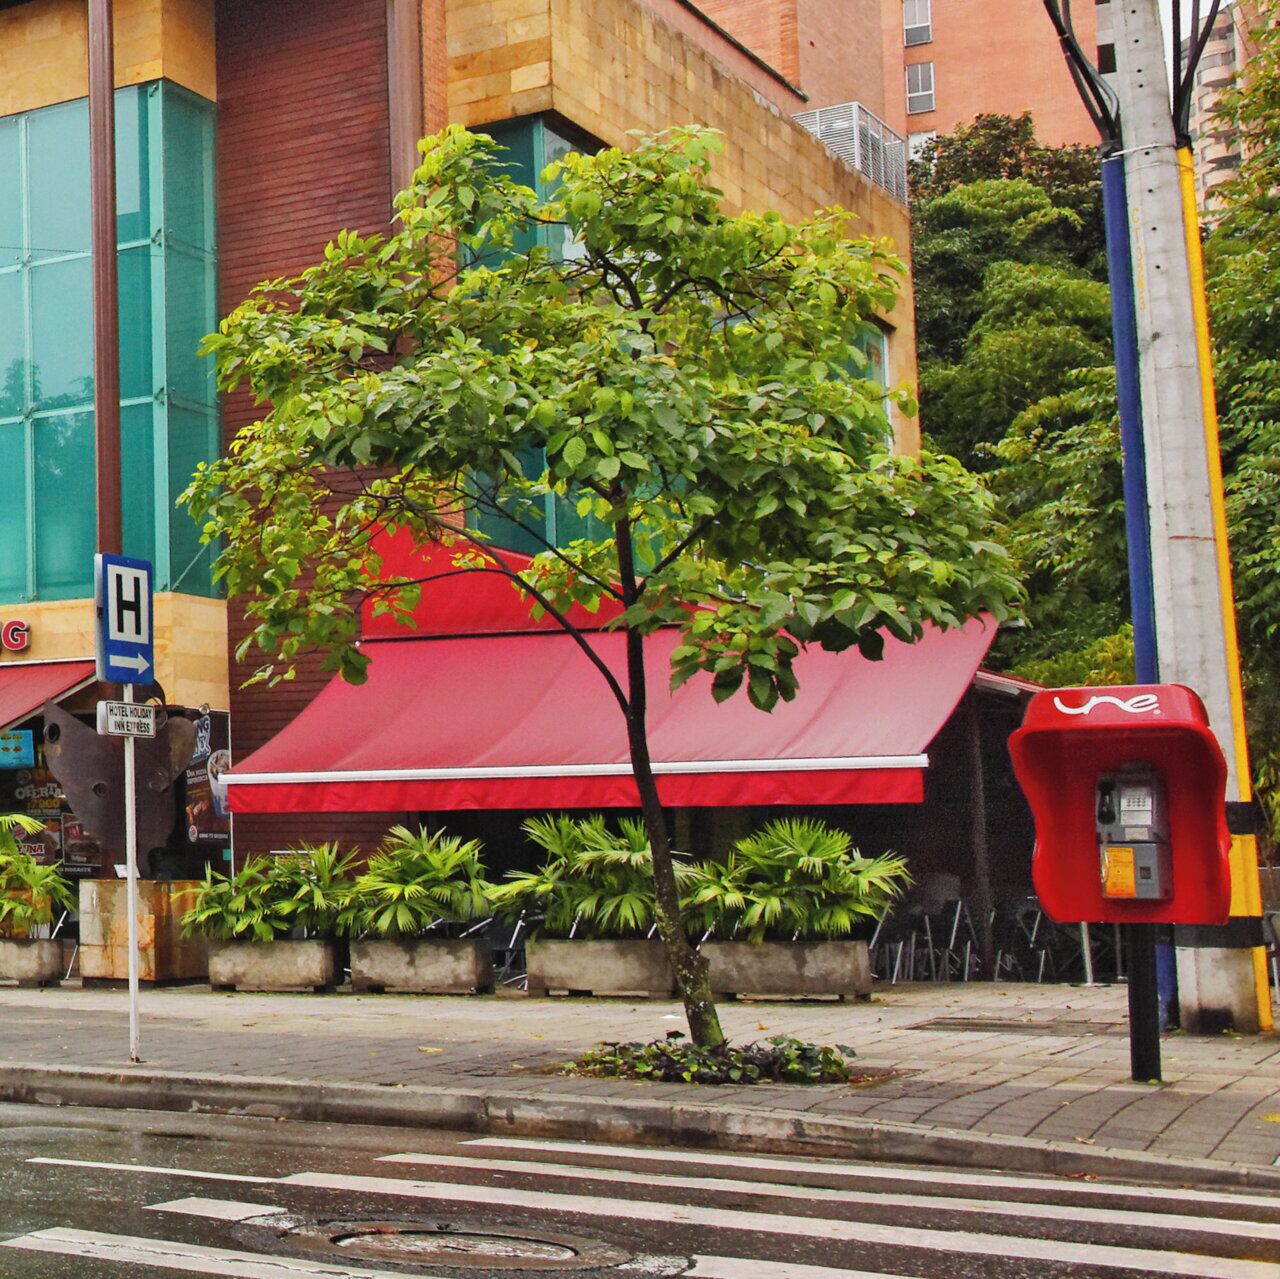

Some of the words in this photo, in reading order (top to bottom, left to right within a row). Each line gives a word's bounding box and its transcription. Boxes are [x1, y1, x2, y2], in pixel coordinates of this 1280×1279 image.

[116, 573, 142, 636] H
[109, 706, 129, 718] HOTEL
[129, 706, 153, 720] HOLIDAY
[114, 721, 126, 732] INN
[126, 722, 150, 734] EXPRESS
